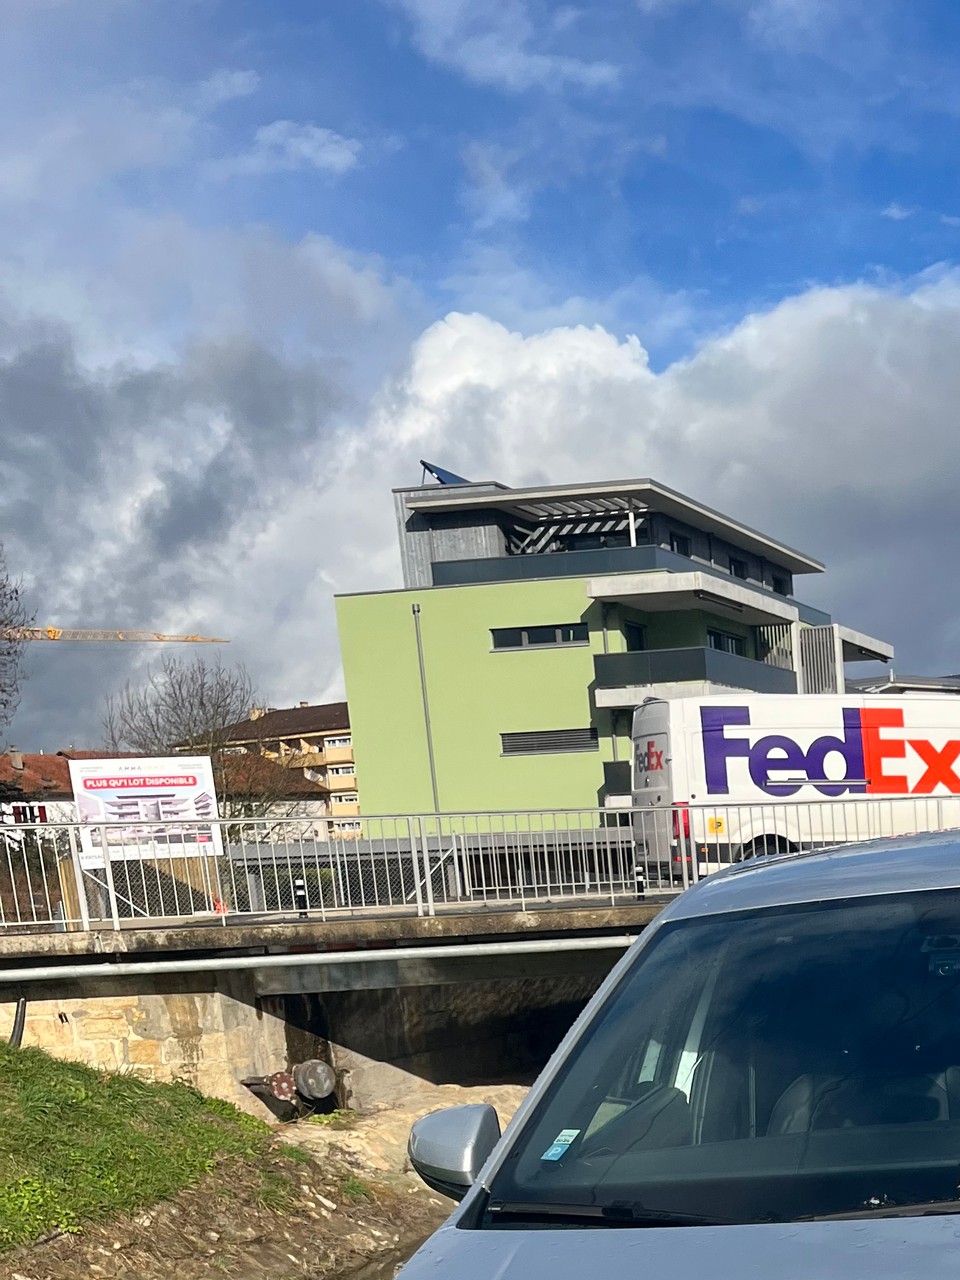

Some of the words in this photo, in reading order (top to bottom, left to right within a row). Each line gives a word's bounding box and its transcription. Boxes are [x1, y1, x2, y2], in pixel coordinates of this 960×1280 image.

[635, 740, 663, 773] FedEx
[86, 779, 108, 788] PLUS
[128, 777, 144, 786] LOT
[145, 777, 194, 785] DISPONIBLE
